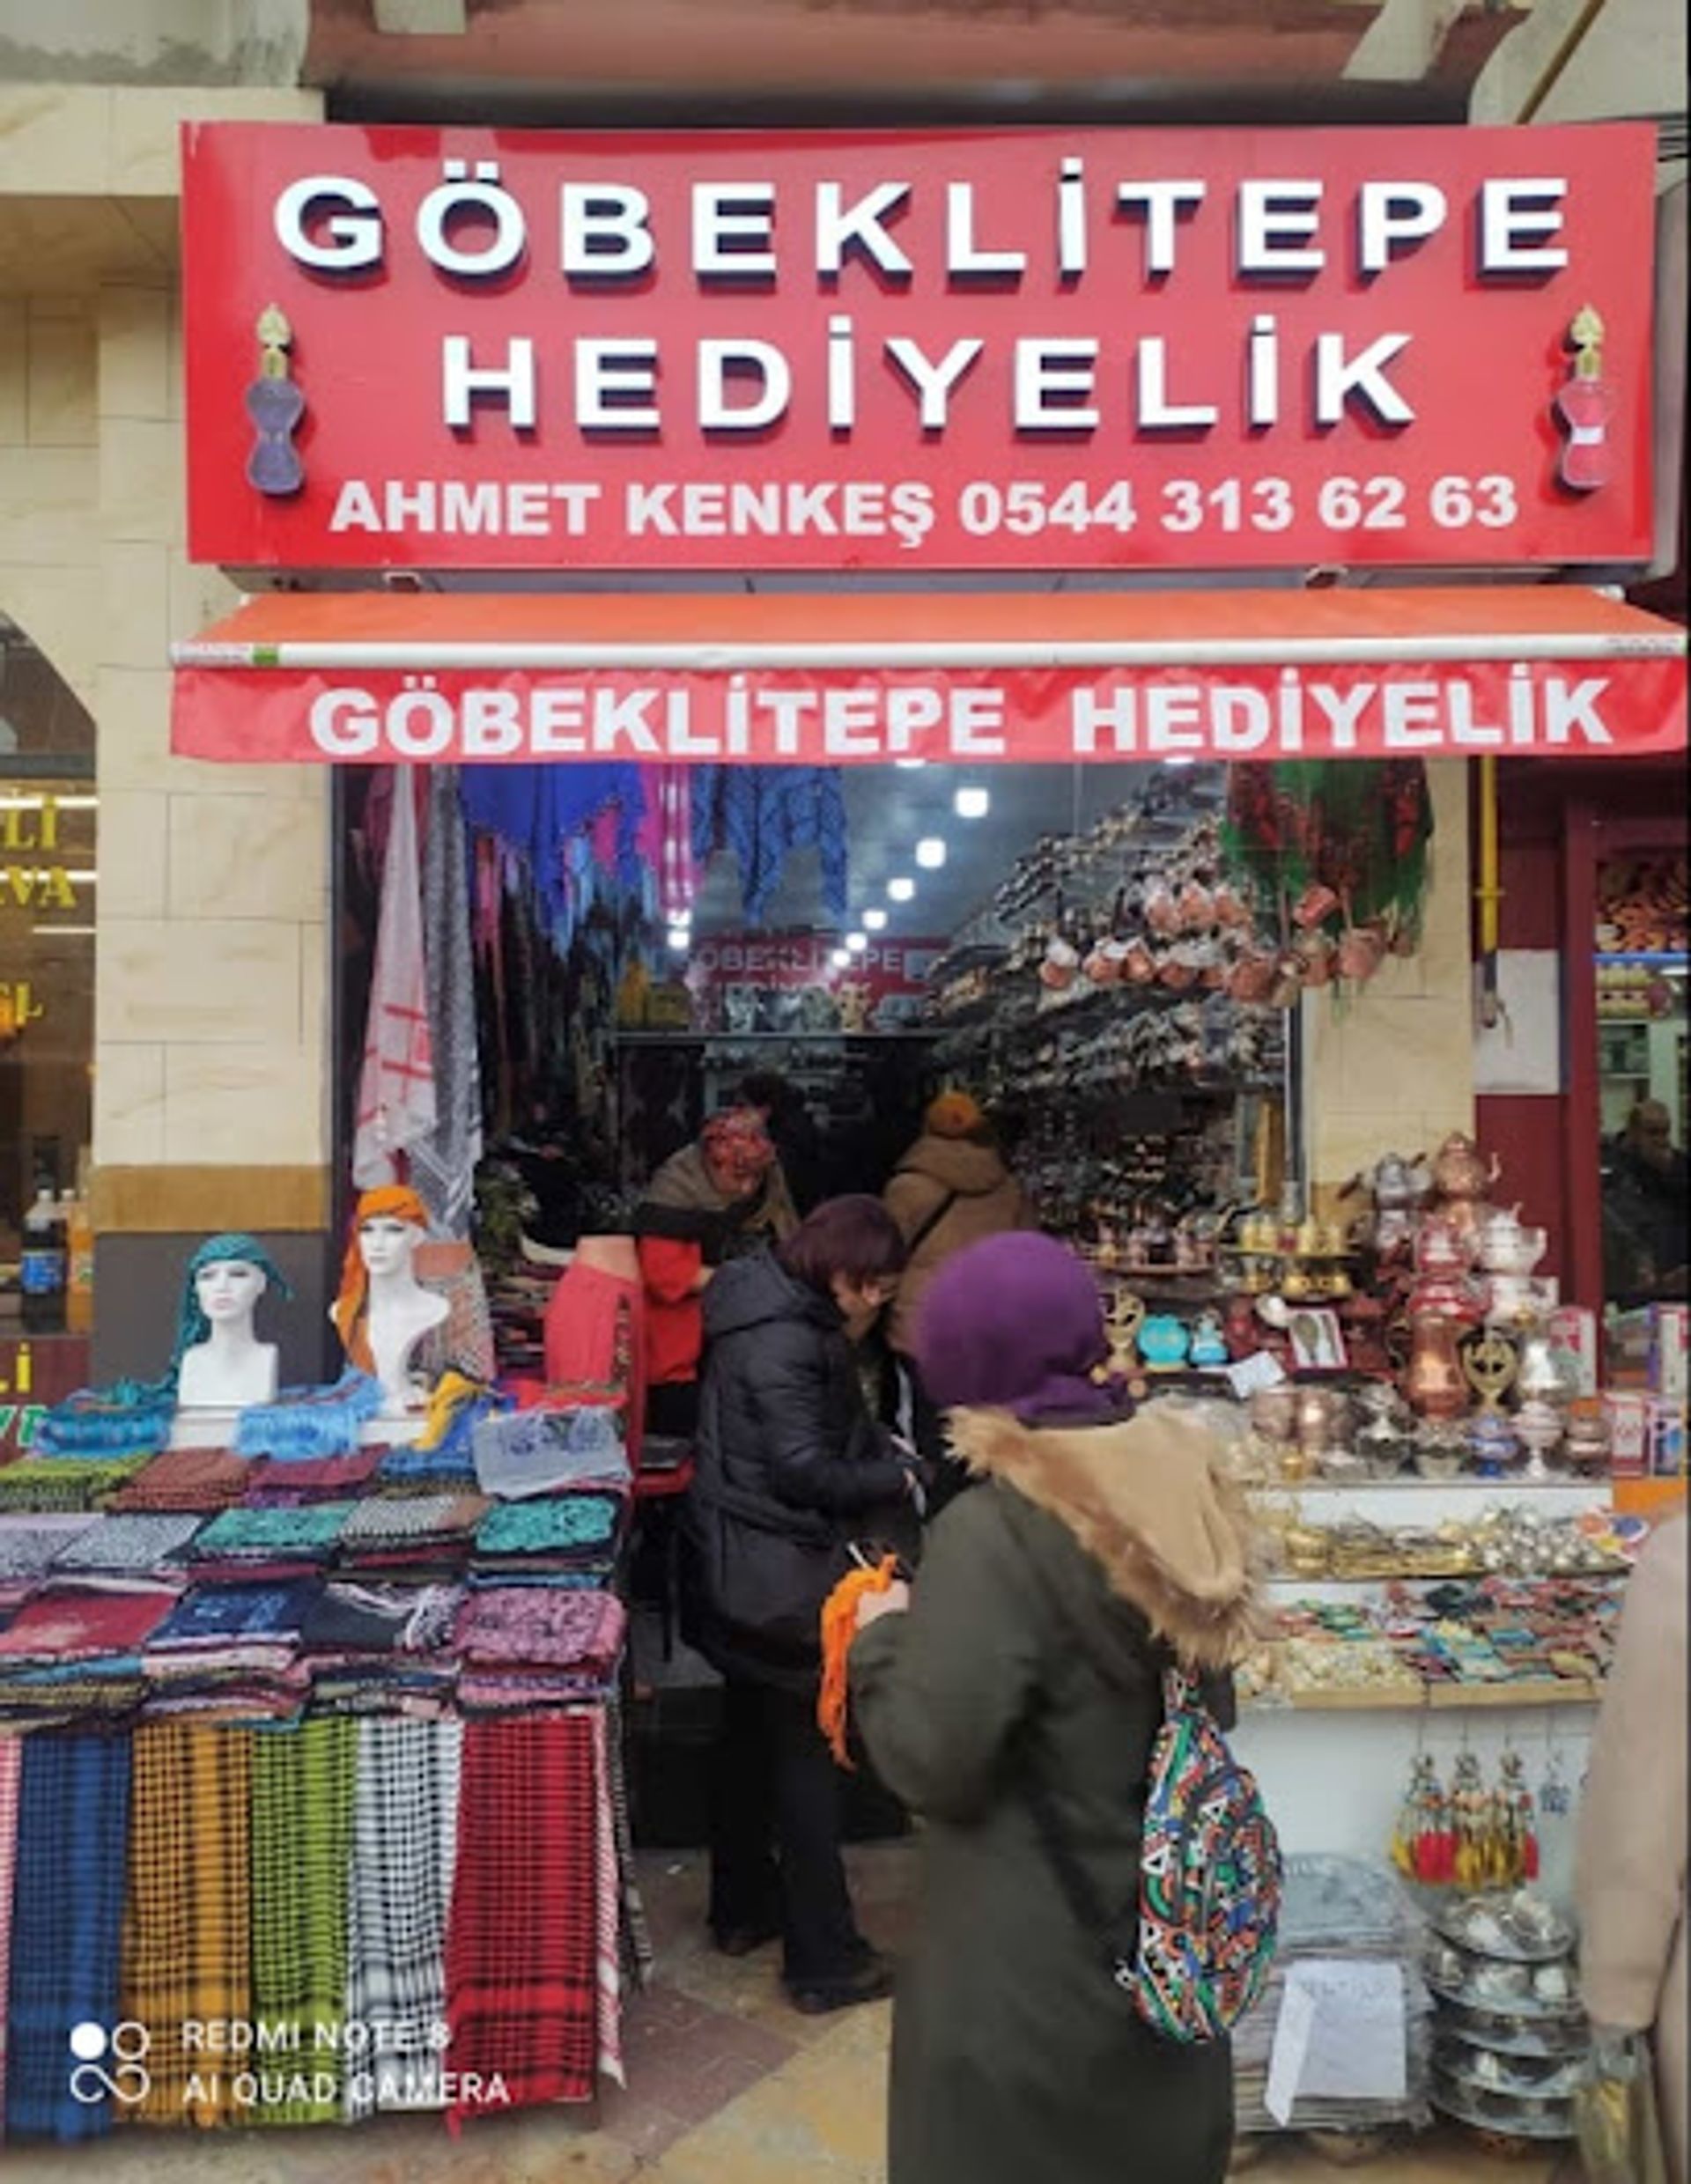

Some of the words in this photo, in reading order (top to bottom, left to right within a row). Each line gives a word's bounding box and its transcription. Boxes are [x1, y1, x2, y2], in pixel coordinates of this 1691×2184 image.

[274, 157, 1569, 273] GÖBEKLİTEPE
[443, 314, 1415, 428] HEDİYELİK
[330, 480, 601, 535] AHMET
[626, 482, 934, 548] KENKEŞ
[959, 480, 1137, 535] 0544
[1160, 477, 1295, 531] 313
[1318, 476, 1407, 529] 62
[1429, 475, 1518, 528] 63
[309, 675, 1006, 756] GÖBEKLİTEPE
[1073, 663, 1612, 751] HEDİYELİK
